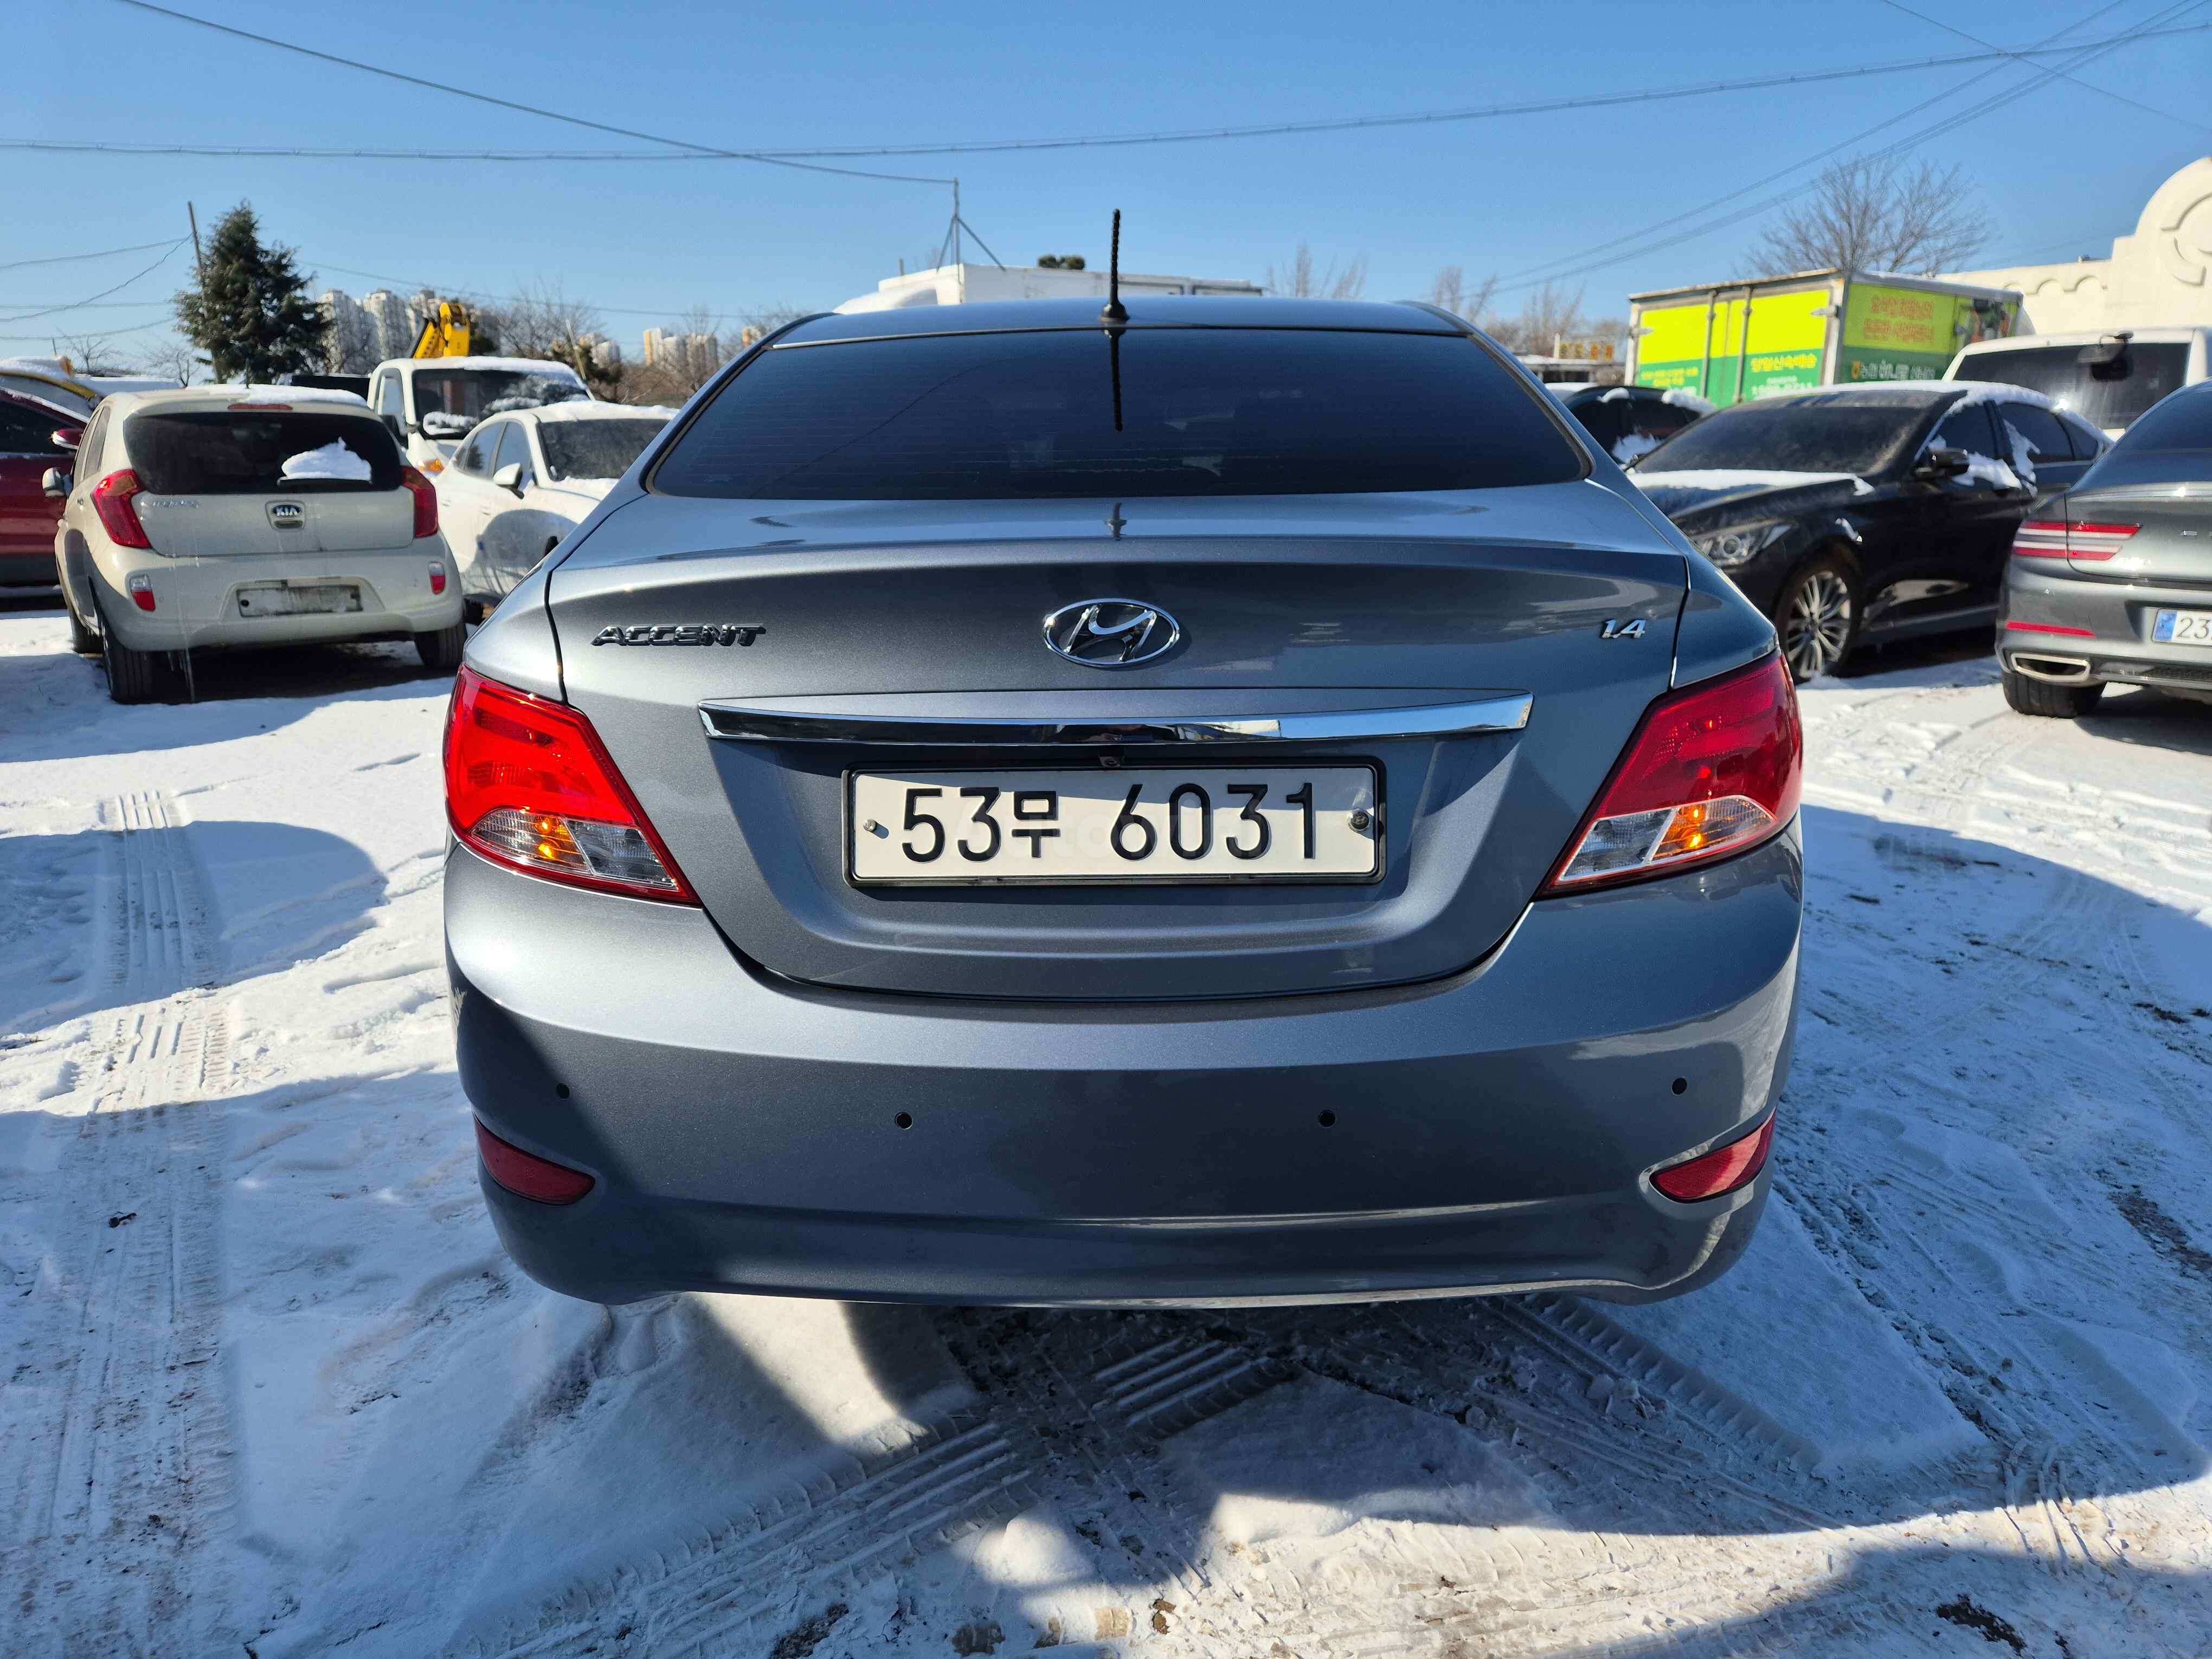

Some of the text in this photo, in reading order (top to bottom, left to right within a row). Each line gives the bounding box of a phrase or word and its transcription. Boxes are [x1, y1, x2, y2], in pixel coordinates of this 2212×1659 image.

[276, 507, 299, 516] KIA
[590, 624, 767, 646] ACCENT
[2177, 617, 2212, 640] 23
[902, 782, 1316, 863] 53무 6031
